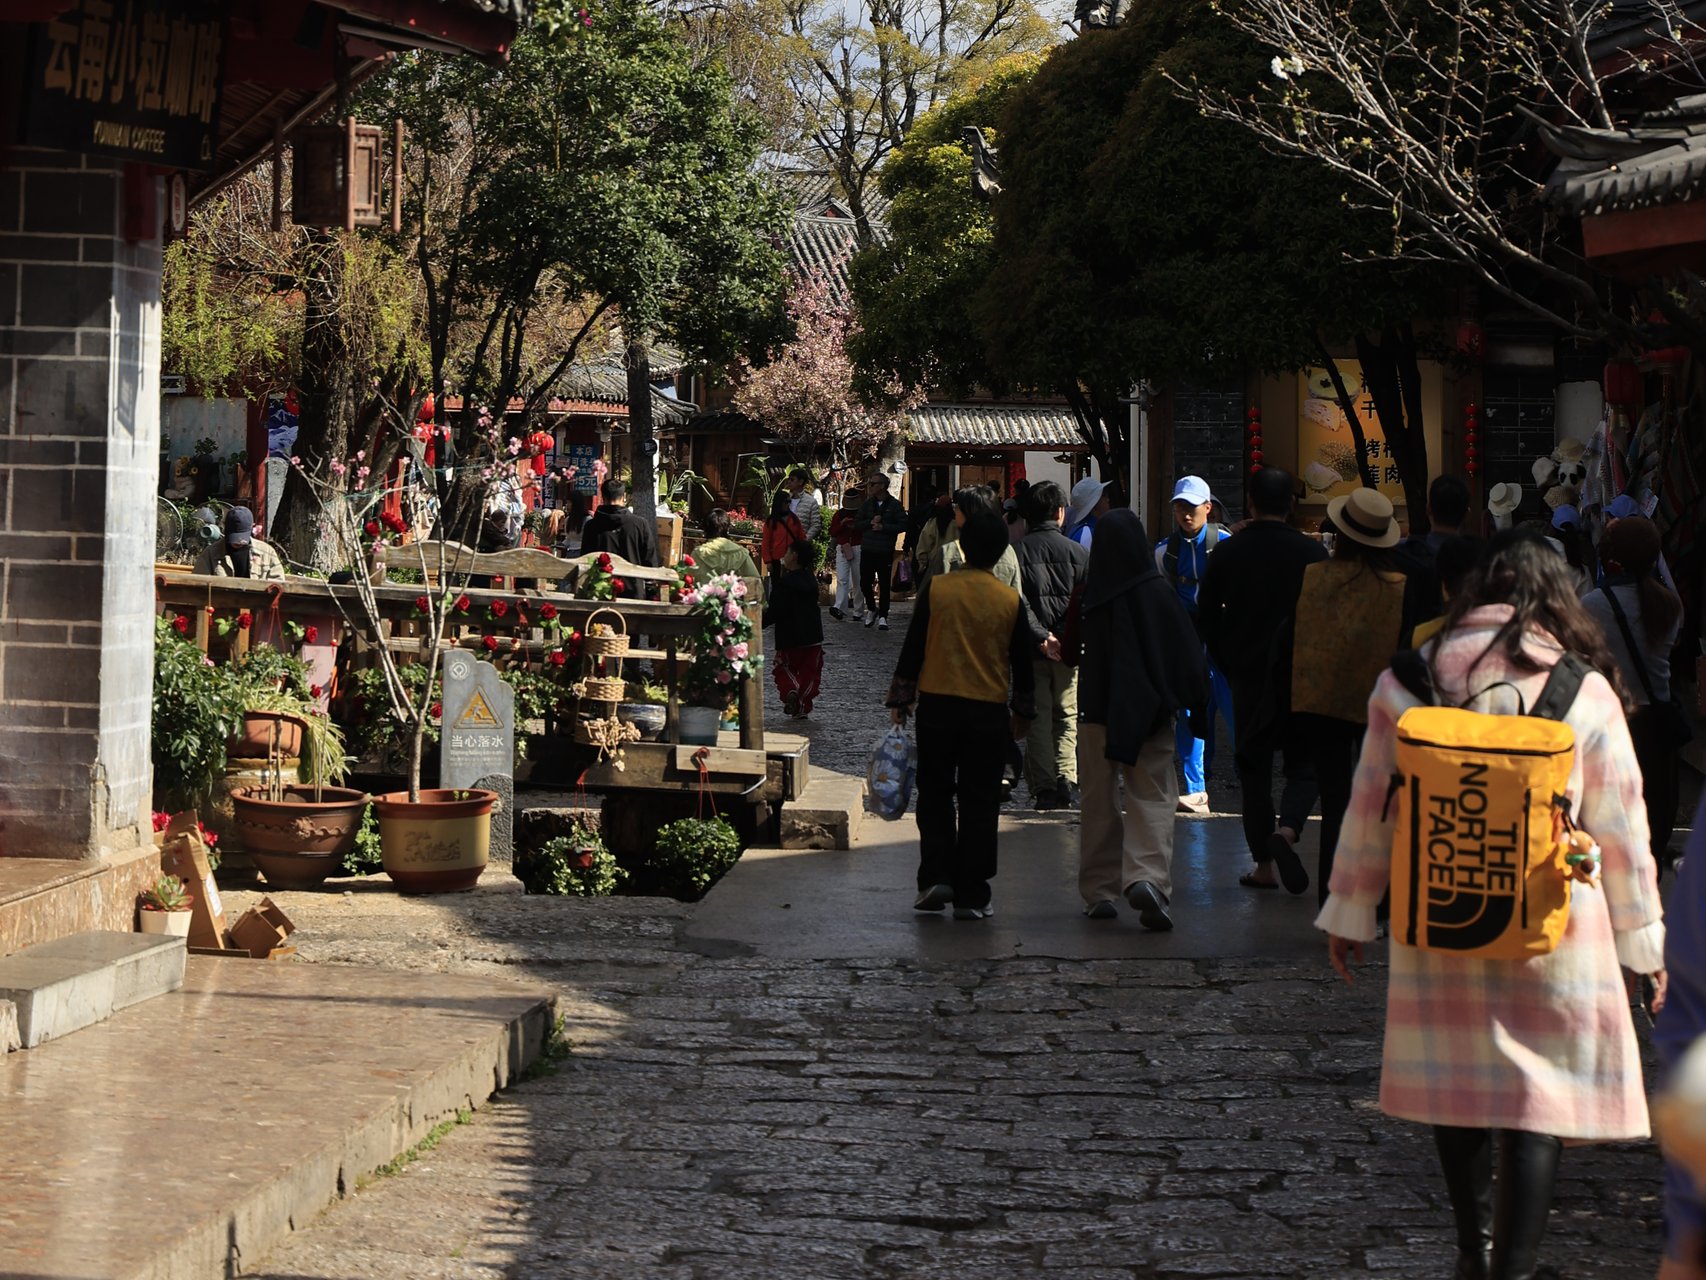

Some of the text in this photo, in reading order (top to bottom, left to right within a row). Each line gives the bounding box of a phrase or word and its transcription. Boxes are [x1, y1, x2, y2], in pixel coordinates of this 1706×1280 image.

[93, 120, 166, 153] YUNNAN COFFEE
[451, 735, 504, 748] 当心落水
[1428, 795, 1456, 886] FACE
[1456, 762, 1489, 890] NORTH
[1487, 822, 1517, 892] THE
